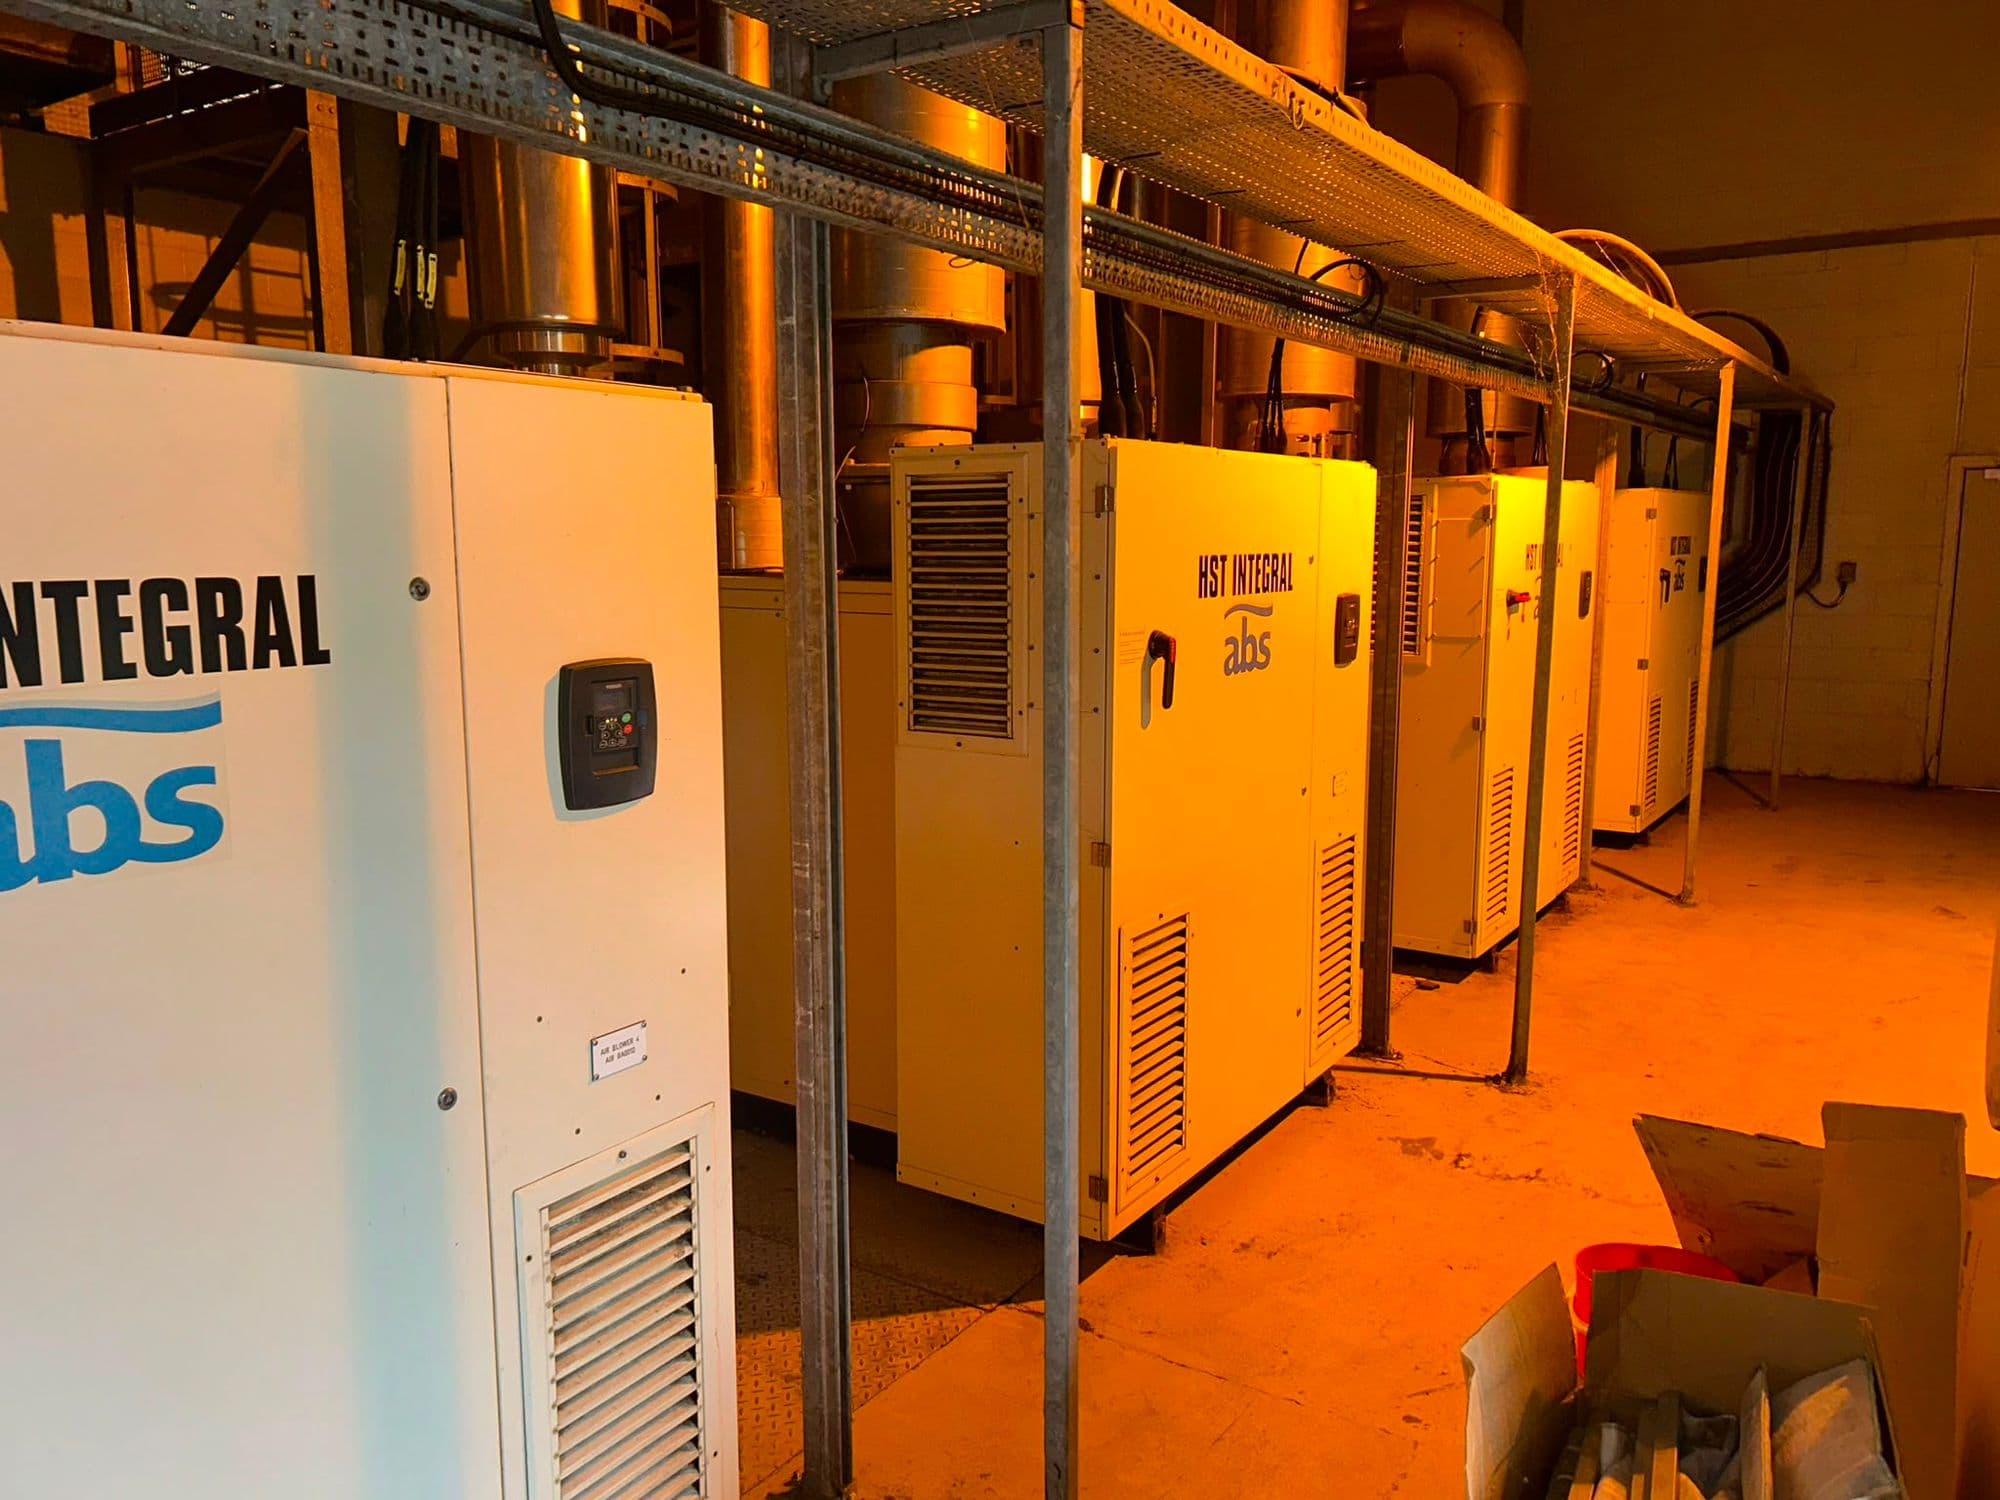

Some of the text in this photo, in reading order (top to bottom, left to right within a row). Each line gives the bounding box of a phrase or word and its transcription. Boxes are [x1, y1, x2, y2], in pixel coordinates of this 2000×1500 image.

[1198, 552, 1293, 598] HST INTEGRAL
[1223, 615, 1271, 676] abs
